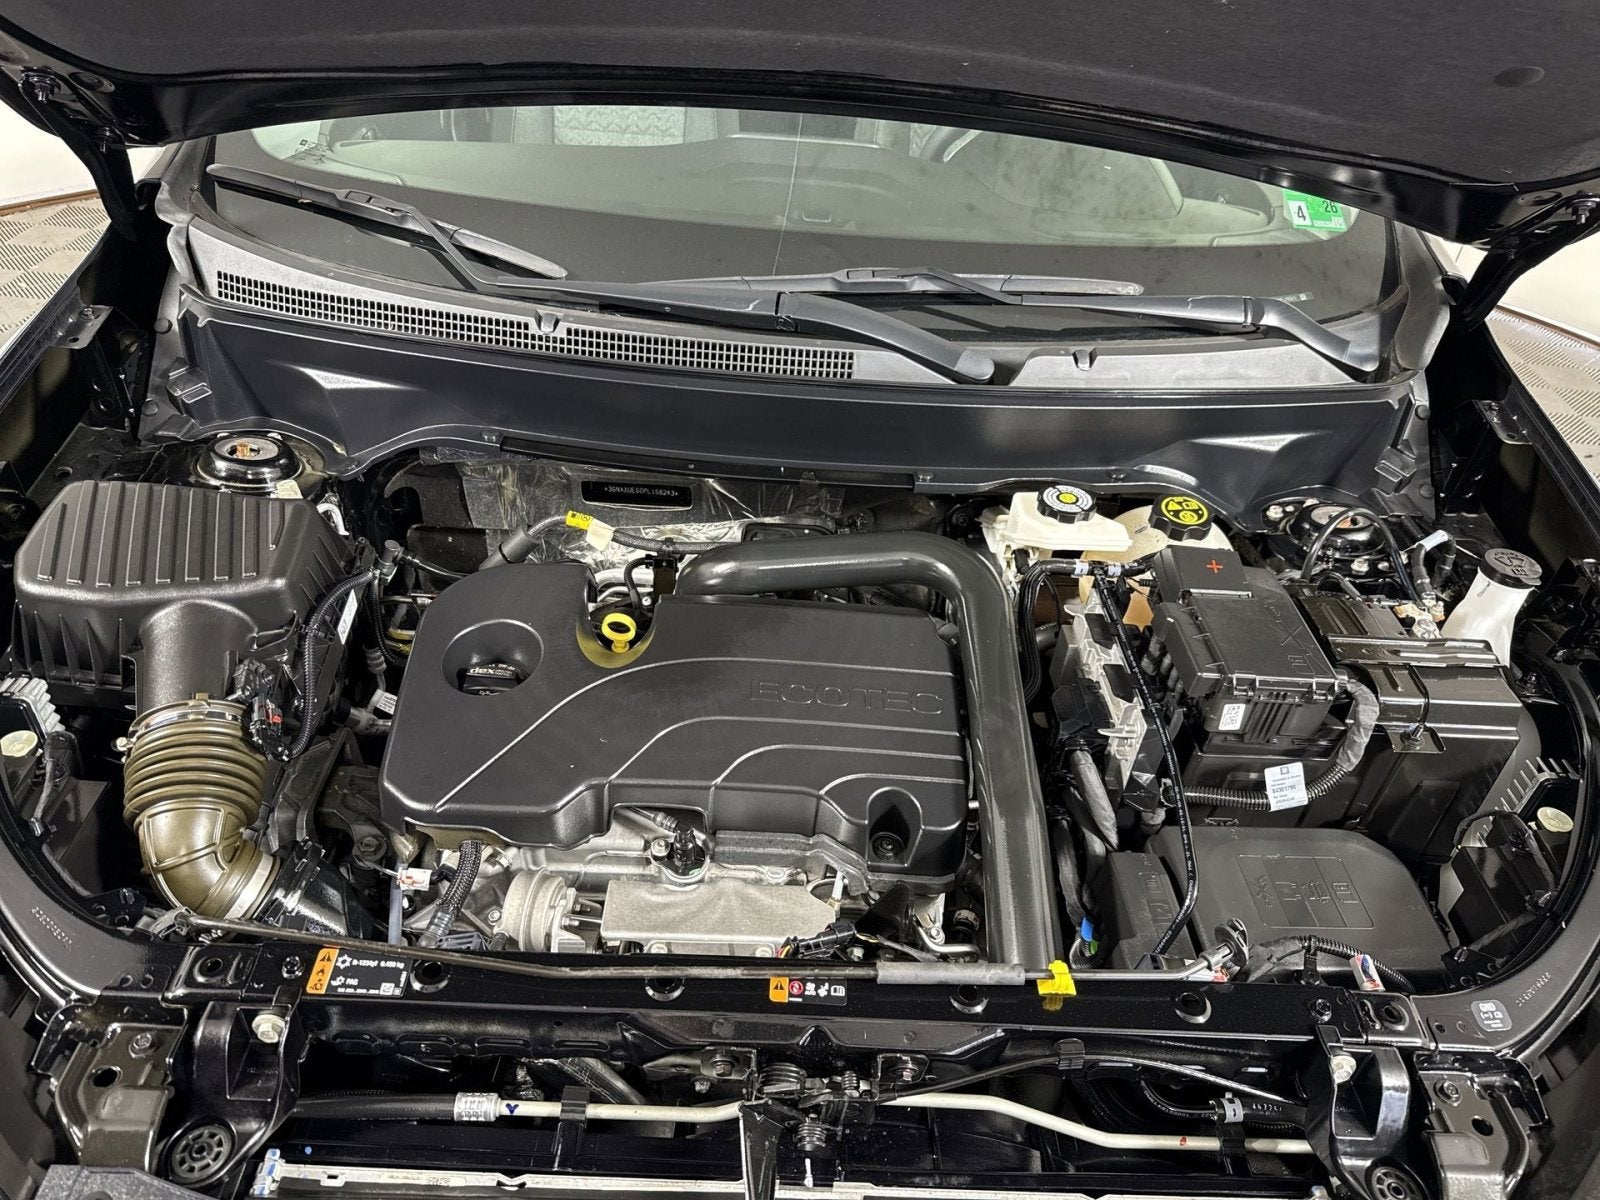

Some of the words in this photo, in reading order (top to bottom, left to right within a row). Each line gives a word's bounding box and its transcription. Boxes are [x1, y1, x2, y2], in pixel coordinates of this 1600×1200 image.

[1297, 205, 1306, 221] 4
[1322, 200, 1338, 213] 26
[750, 679, 944, 715] ECOTEC
